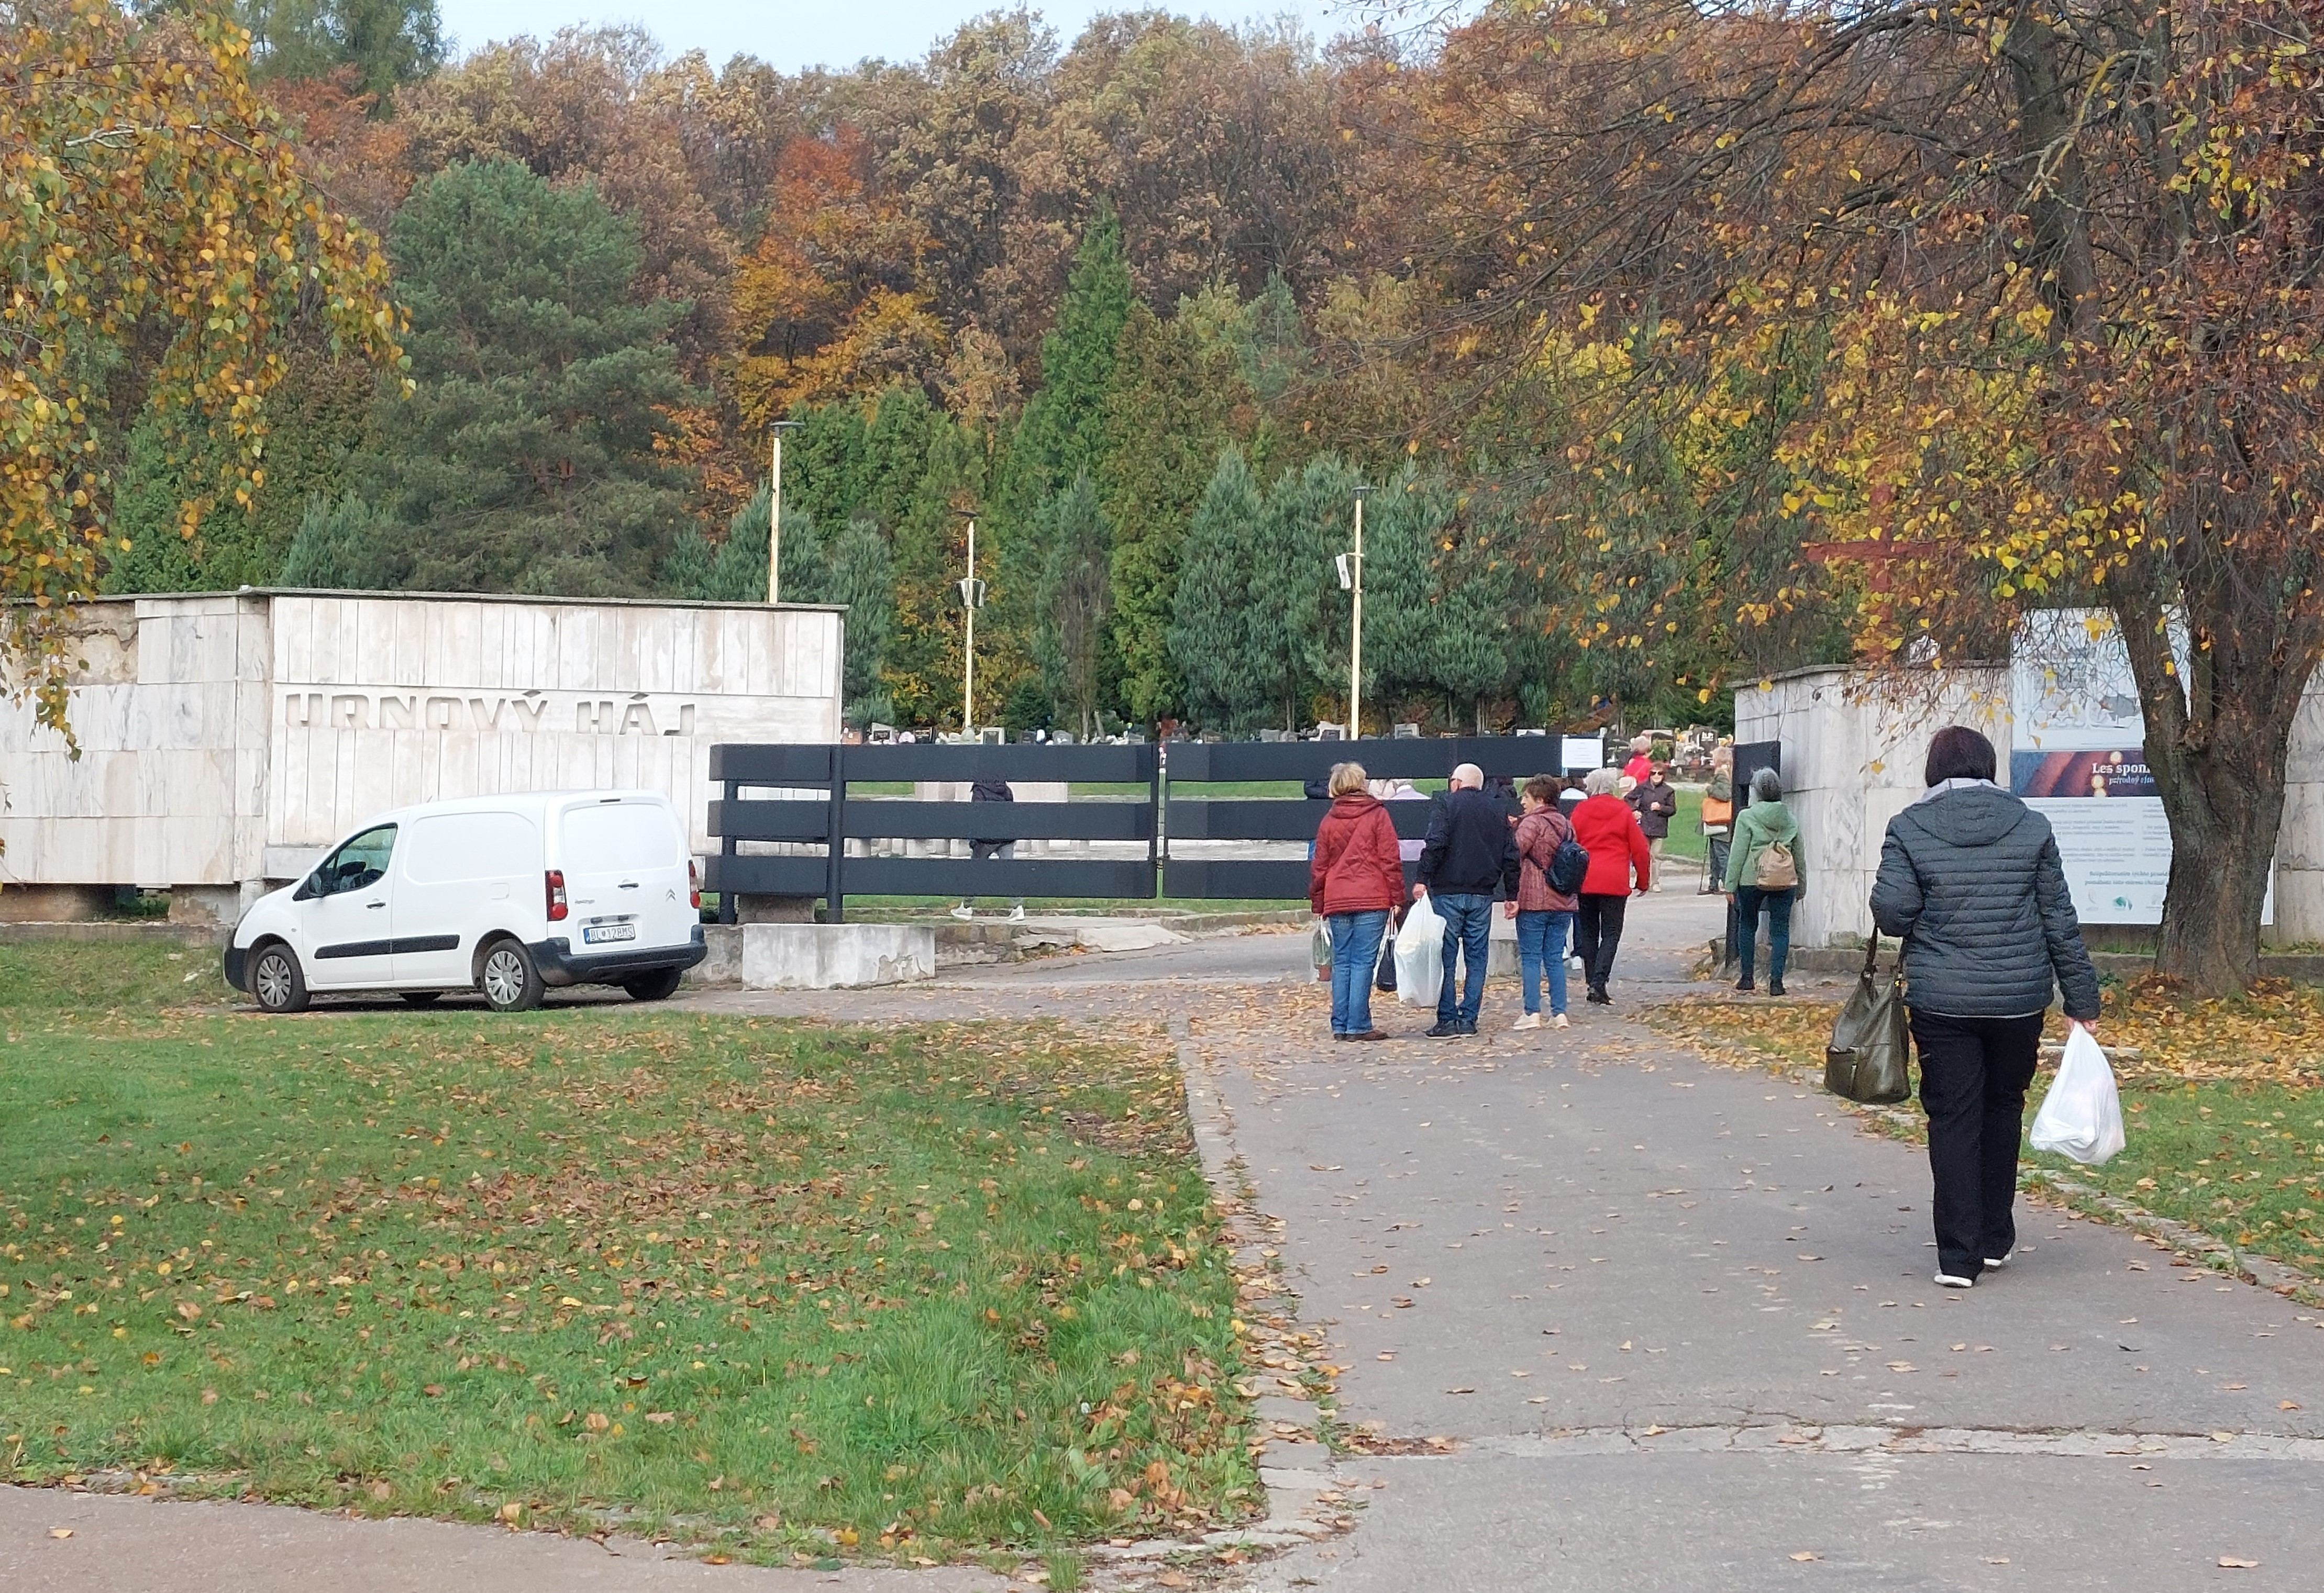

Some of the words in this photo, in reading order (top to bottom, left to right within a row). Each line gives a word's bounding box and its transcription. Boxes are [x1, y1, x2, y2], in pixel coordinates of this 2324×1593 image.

[285, 689, 548, 732] URNOVÝ
[577, 692, 695, 736] HÁJ
[2092, 763, 2113, 774] Les
